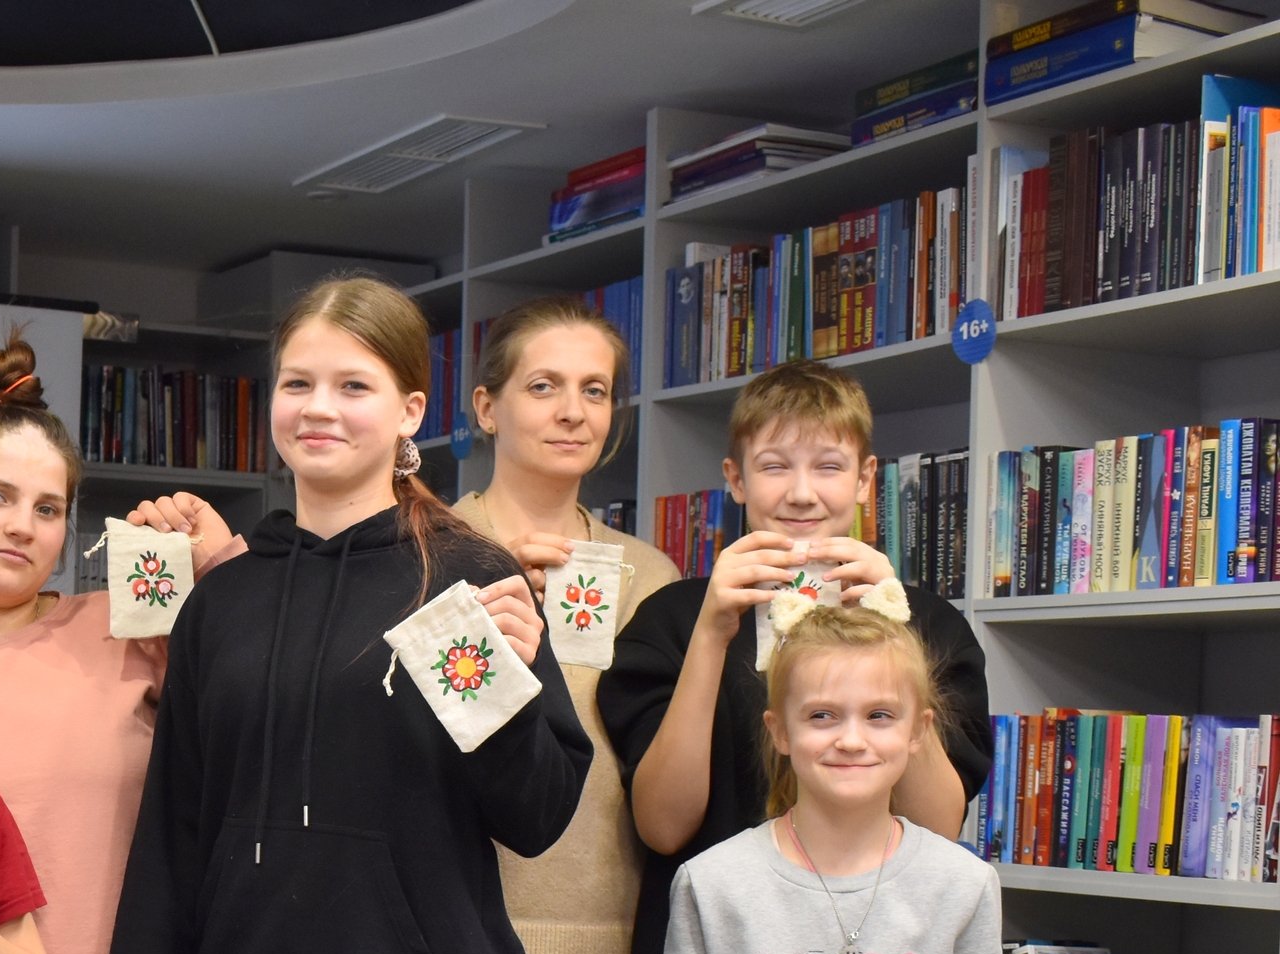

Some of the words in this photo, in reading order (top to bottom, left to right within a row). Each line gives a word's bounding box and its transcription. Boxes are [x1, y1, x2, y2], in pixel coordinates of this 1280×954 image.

[959, 319, 989, 340] 16+
[1121, 446, 1129, 484] МАРКУС
[1241, 422, 1254, 474] ДЖОНАТАН
[1097, 451, 1105, 487] ЗУСАК
[1203, 453, 1212, 483] КАФКА
[1042, 466, 1052, 534] САНКТУАРИЙ
[1203, 486, 1212, 516] ФРАНЦ
[1239, 479, 1252, 539] КЕЛЛЕРМАН
[1020, 524, 1028, 544] ТЕБЯ
[1063, 524, 1070, 537] ТЫ
[1080, 524, 1087, 536] ОТ
[1097, 500, 1106, 551] ГЛИНЯНЫЙ
[1114, 502, 1123, 556] КНИЖНЫЙ
[1182, 494, 1197, 570] НАРЕЧЕННАЯ
[1259, 526, 1268, 544] КЕНТ
[1020, 547, 1027, 558] НЕ
[1062, 541, 1070, 581] БУДЕШЬ
[1095, 553, 1103, 579] МОСТ
[1259, 547, 1267, 574] МИНКА
[1018, 560, 1026, 589] СТАЛО
[1221, 759, 1229, 802] МАЛЕНЬКАЯ
[1059, 778, 1070, 844] ПАССАЖИРЫ
[1216, 817, 1225, 862] МОРИАРТИ
